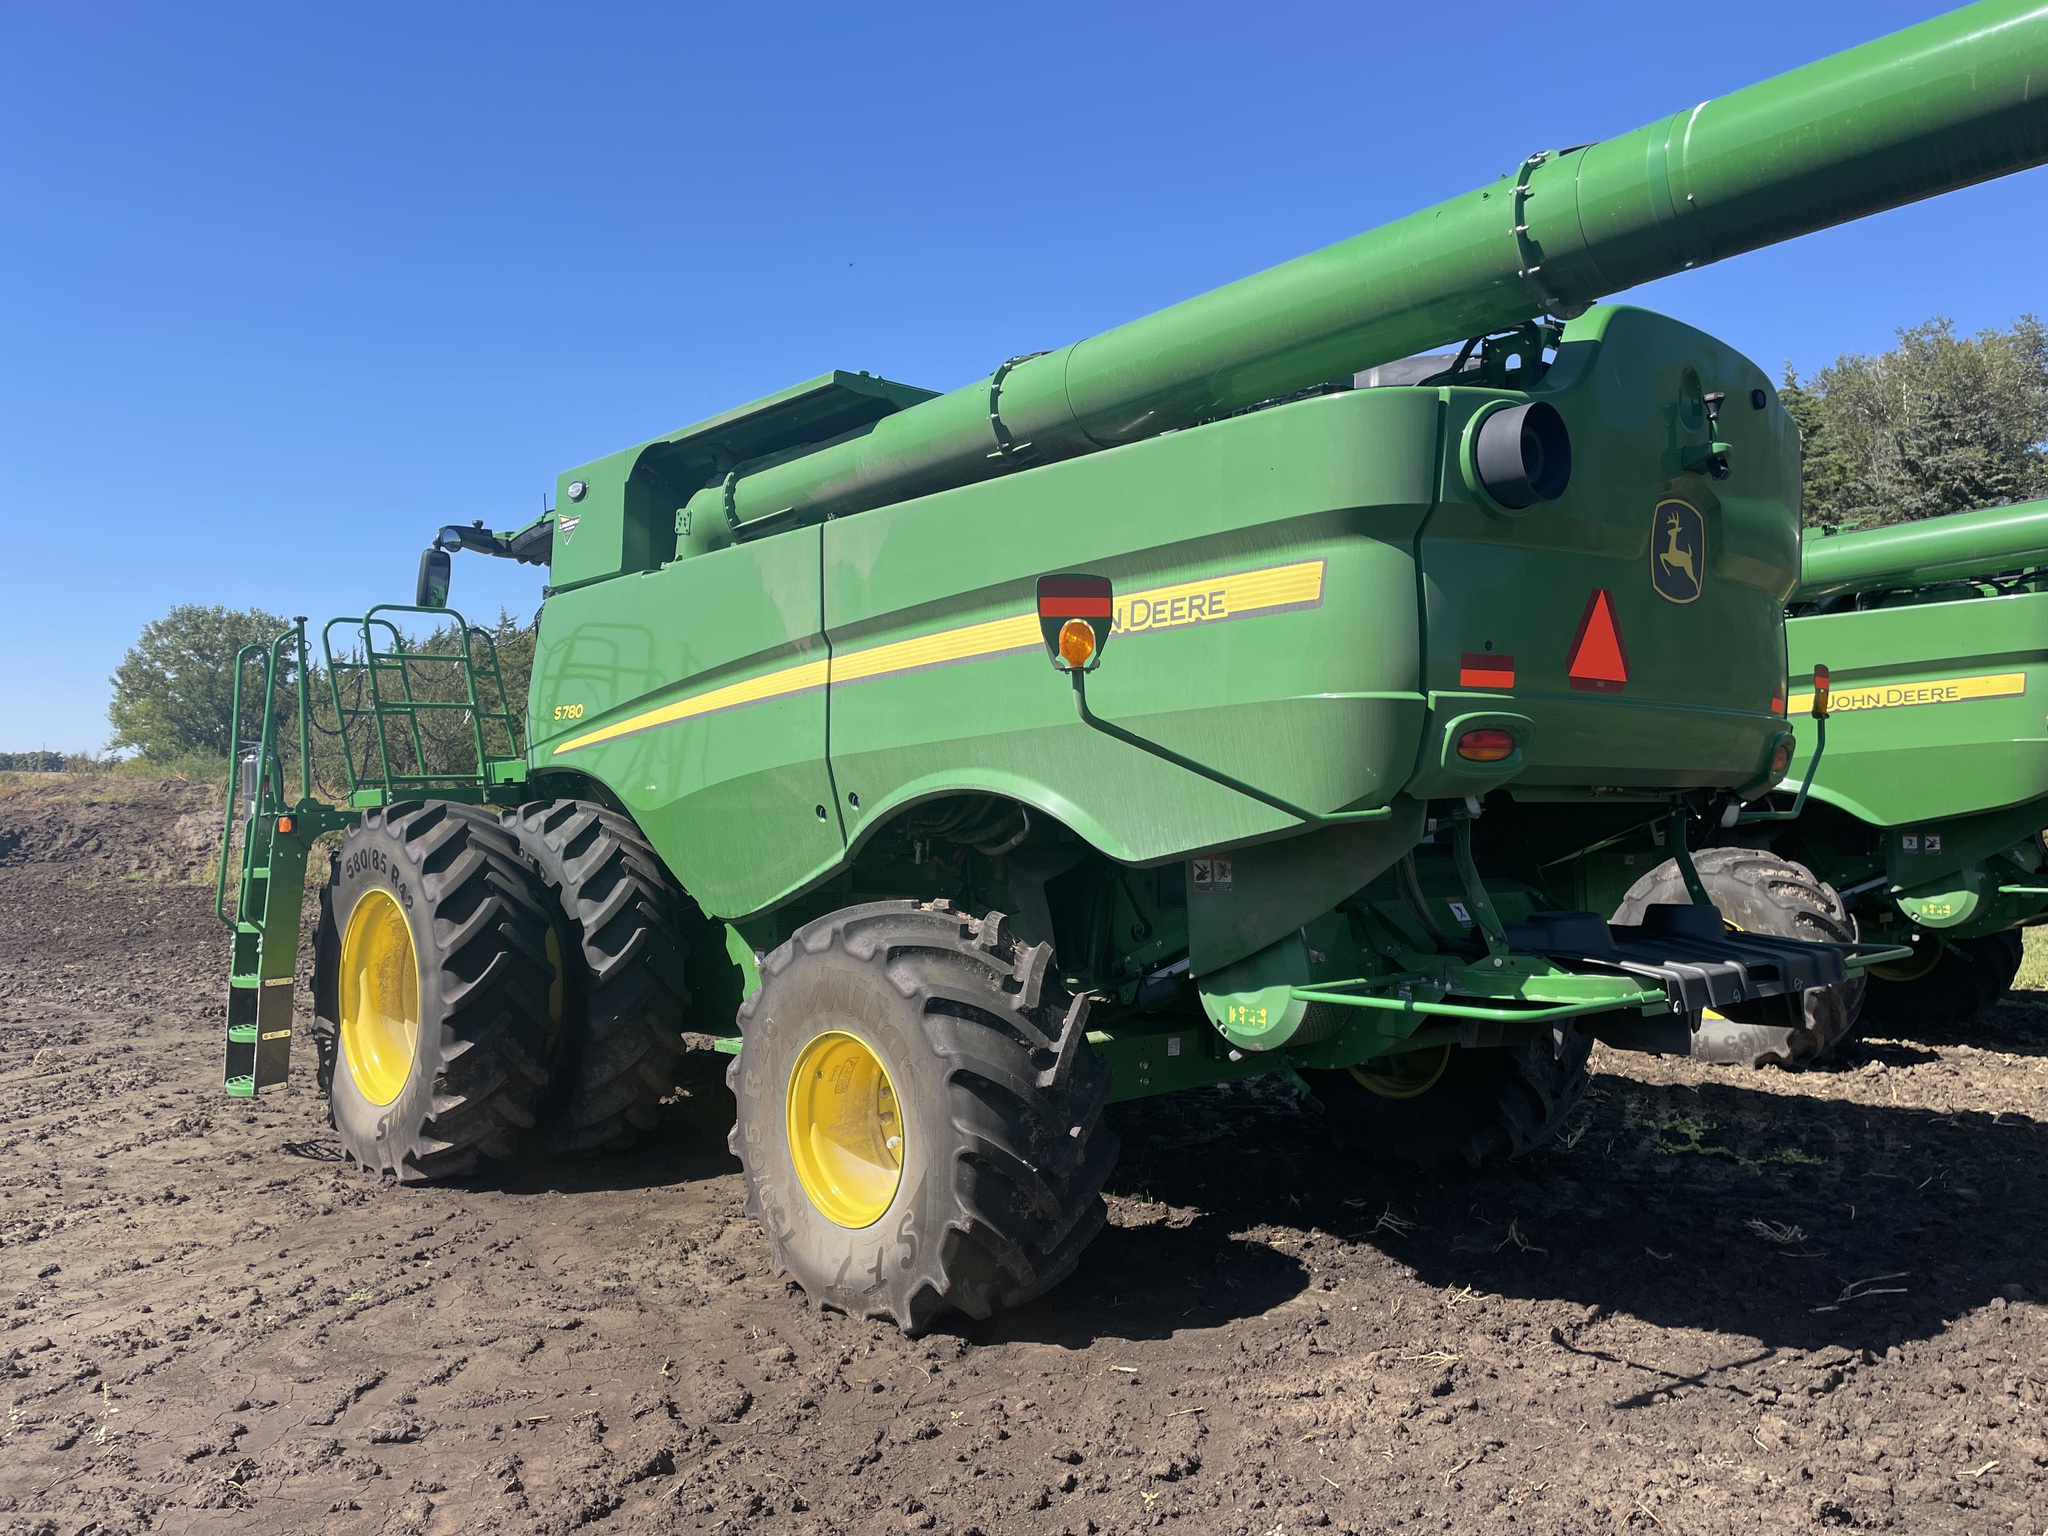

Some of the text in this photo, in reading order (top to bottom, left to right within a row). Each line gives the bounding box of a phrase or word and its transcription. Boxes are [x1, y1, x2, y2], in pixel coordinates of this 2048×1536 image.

[1130, 590, 1226, 628] DEERE
[553, 703, 584, 721] S780
[1827, 686, 1958, 709] JOHN DEERE
[345, 846, 388, 880] 580/85
[398, 882, 414, 916] 42
[806, 966, 926, 1108] Mitas
